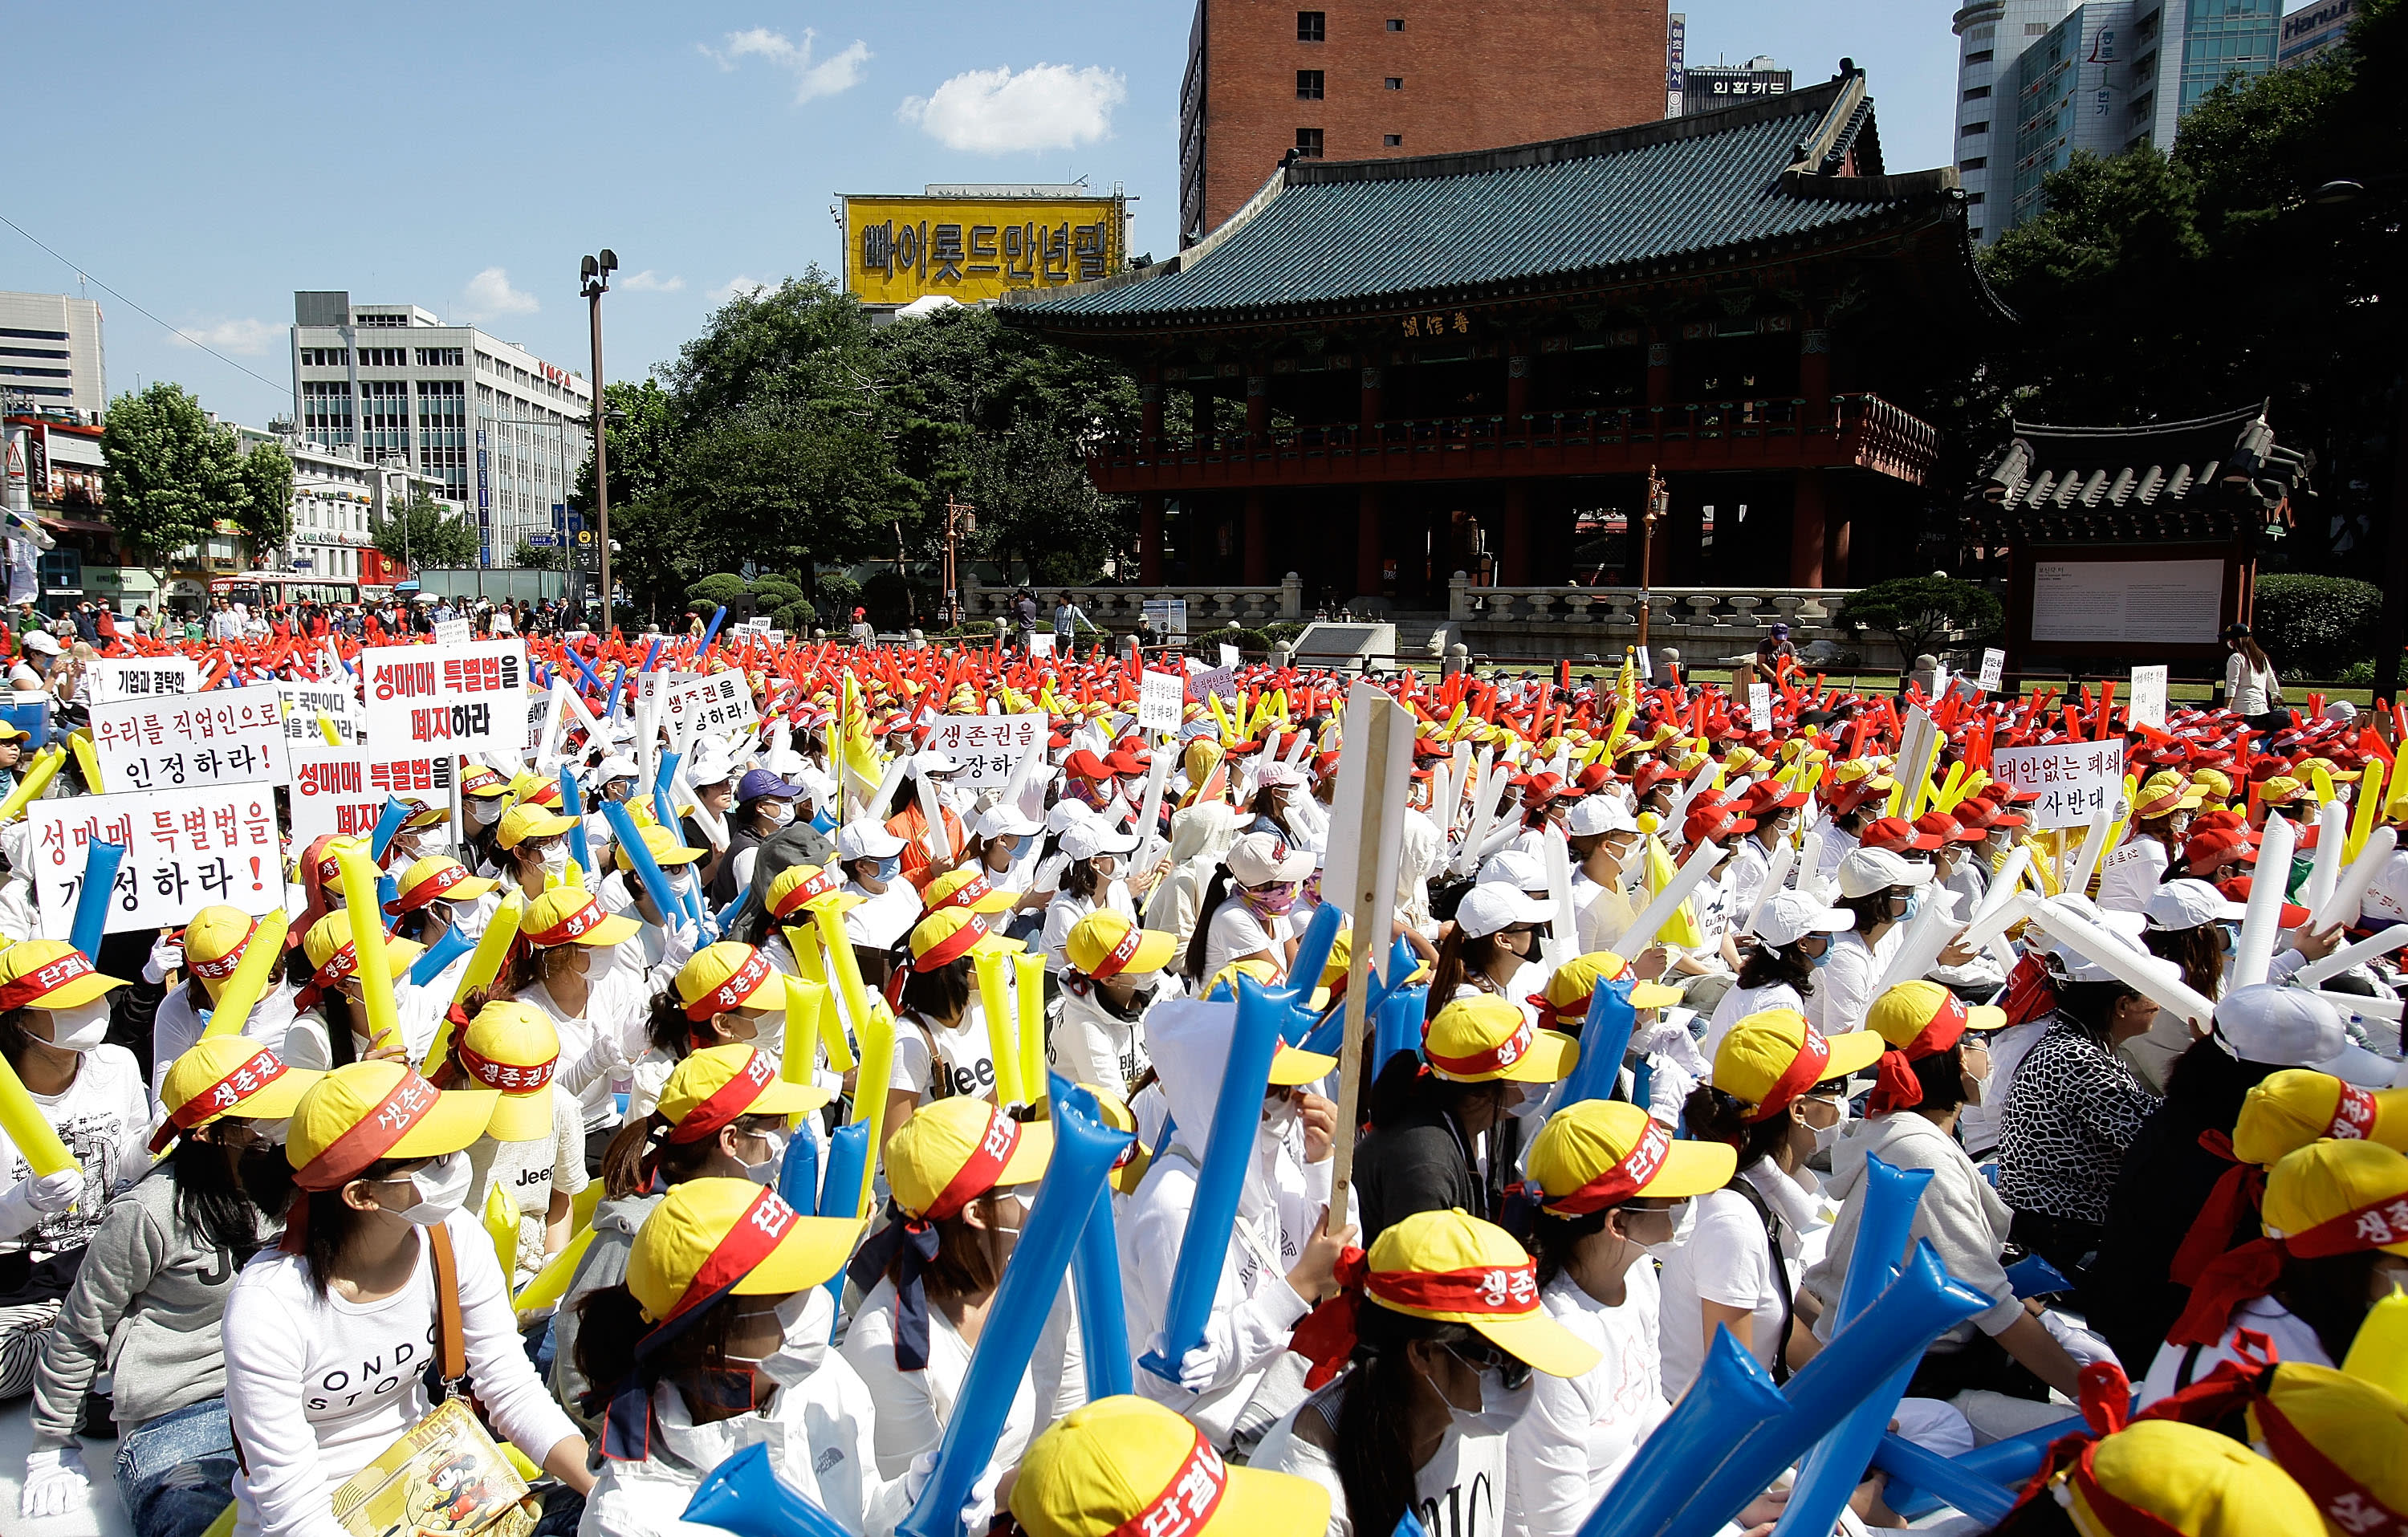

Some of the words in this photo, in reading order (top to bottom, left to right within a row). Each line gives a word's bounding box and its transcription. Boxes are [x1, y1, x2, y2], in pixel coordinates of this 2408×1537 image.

[539, 361, 571, 388] YMCA
[212, 582, 230, 592] 5500
[118, 670, 150, 693] 기업과
[154, 671, 185, 694] 결탁한
[374, 662, 435, 700] 성매매
[444, 655, 519, 693] 특별법을
[1201, 673, 1232, 690] 직업인으로
[299, 692, 344, 713] 국민이다
[98, 713, 165, 751] 우리를
[173, 704, 280, 740] 직업인으로
[412, 703, 490, 742] 폐지하라
[938, 722, 1035, 748] 생존권을
[126, 744, 270, 789] 인정하라!
[298, 762, 362, 795] 성매매
[371, 758, 449, 791] 특별법을
[1998, 755, 2081, 785] 대안없는
[2088, 749, 2121, 778] 폐쇄
[336, 804, 385, 836] 폐지
[2033, 787, 2104, 818] 사반대
[41, 813, 134, 865] 성매매
[151, 803, 270, 853] 특별법을
[944, 1058, 995, 1097] Jee
[1474, 1268, 1537, 1307] 생존
